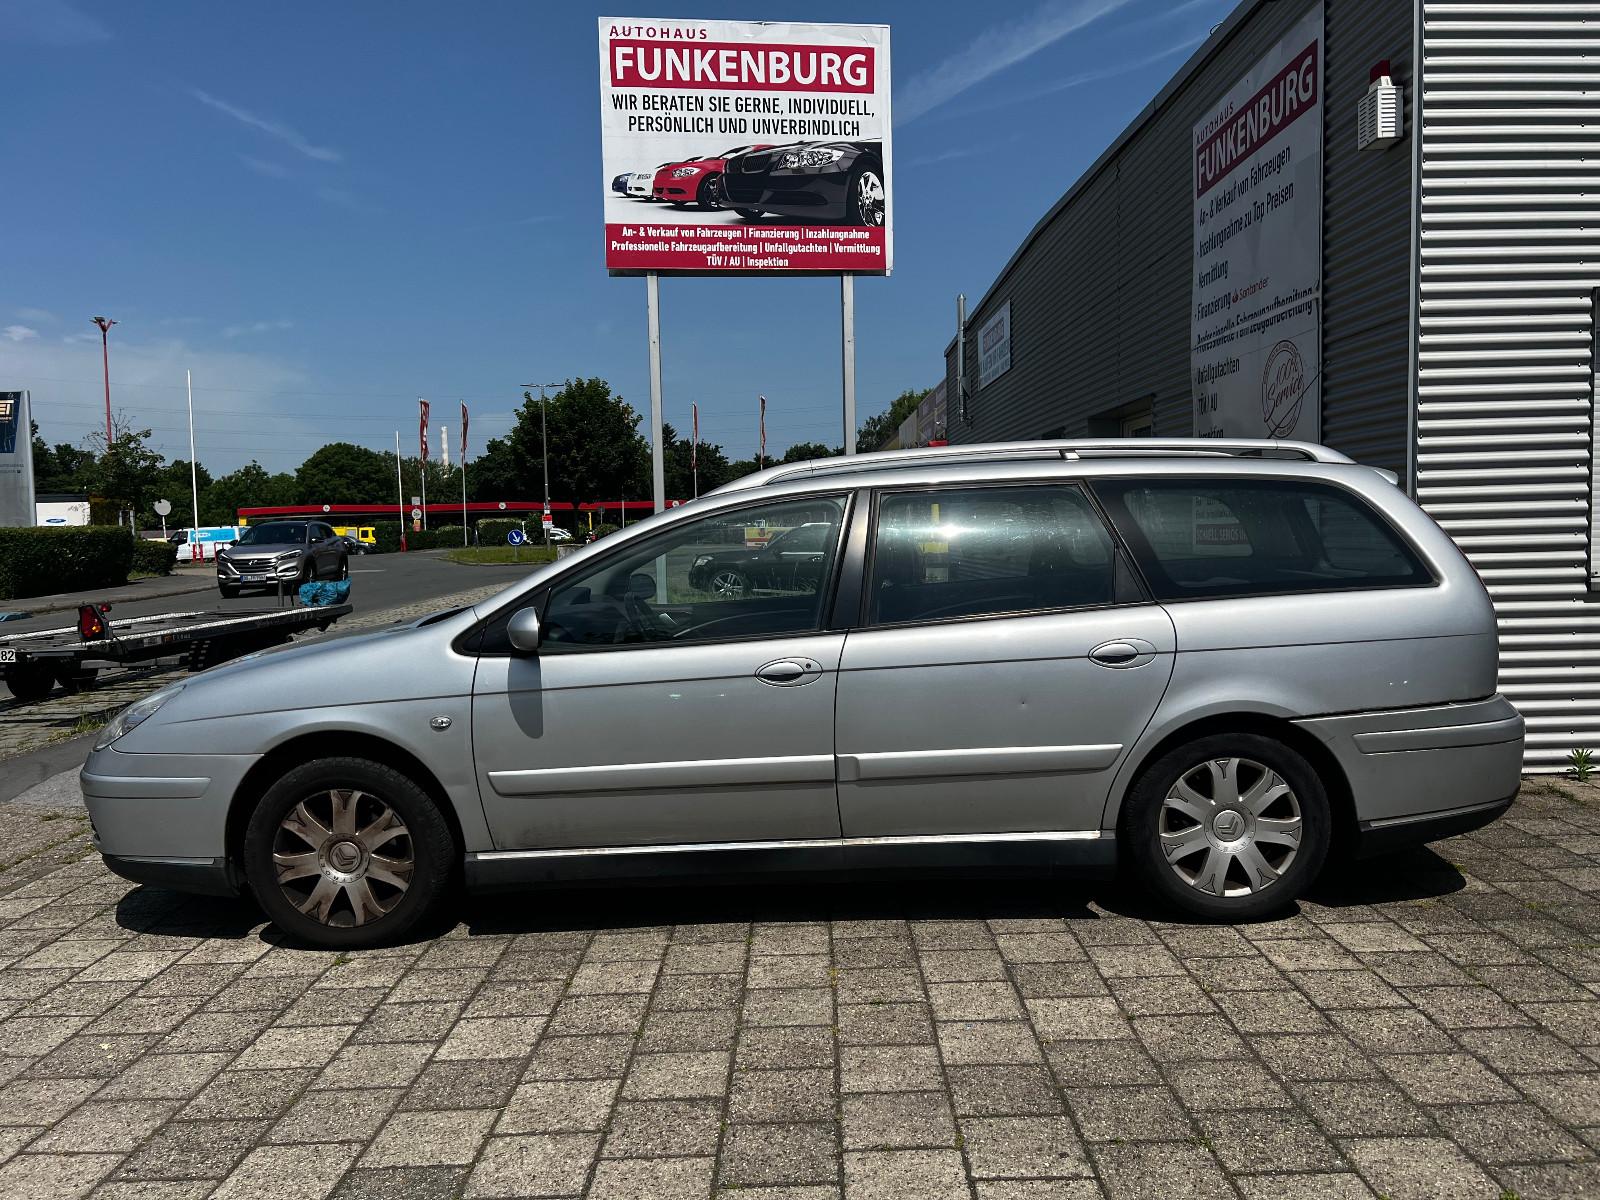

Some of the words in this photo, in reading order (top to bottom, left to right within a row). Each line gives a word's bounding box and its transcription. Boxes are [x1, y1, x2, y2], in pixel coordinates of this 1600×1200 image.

[609, 26, 708, 40] AUTOHAUS
[615, 46, 867, 86] FUNKENBURG
[612, 94, 637, 110] WIR
[642, 95, 704, 112] BERATEN
[709, 96, 730, 112] SIE
[735, 97, 784, 115] GERNE,
[789, 98, 875, 117] INDIVIDUELL,
[629, 113, 714, 134] PERSÖNLICH
[719, 118, 747, 134] UND
[753, 119, 860, 136] UNVERBINDLICH
[1196, 101, 1234, 144] AUTOHAUS
[1198, 55, 1313, 190] FUNKENBURG
[1215, 180, 1236, 214] Verkauf
[1238, 176, 1248, 198] von
[1251, 144, 1290, 186] Fahrzeugen
[1244, 210, 1252, 228] zu
[1253, 200, 1264, 222] Top
[1266, 182, 1294, 214] Preisen
[622, 228, 636, 237] An-
[639, 228, 645, 237] &
[647, 228, 678, 238] Verkauf
[681, 230, 694, 238] von
[697, 228, 742, 239] Fahrzeugen
[749, 228, 799, 241] Finanzierung
[806, 229, 870, 241] Inzahlungnahme
[612, 241, 669, 252] Professionelle
[671, 242, 757, 254] Fahrzeugaufbereitung
[765, 242, 827, 254] Unfallgutachten
[834, 244, 880, 255] Vermittlung
[707, 253, 722, 266] TÜV
[730, 256, 740, 266] AU
[747, 257, 788, 268] Inspektion
[0, 650, 14, 661] 82
